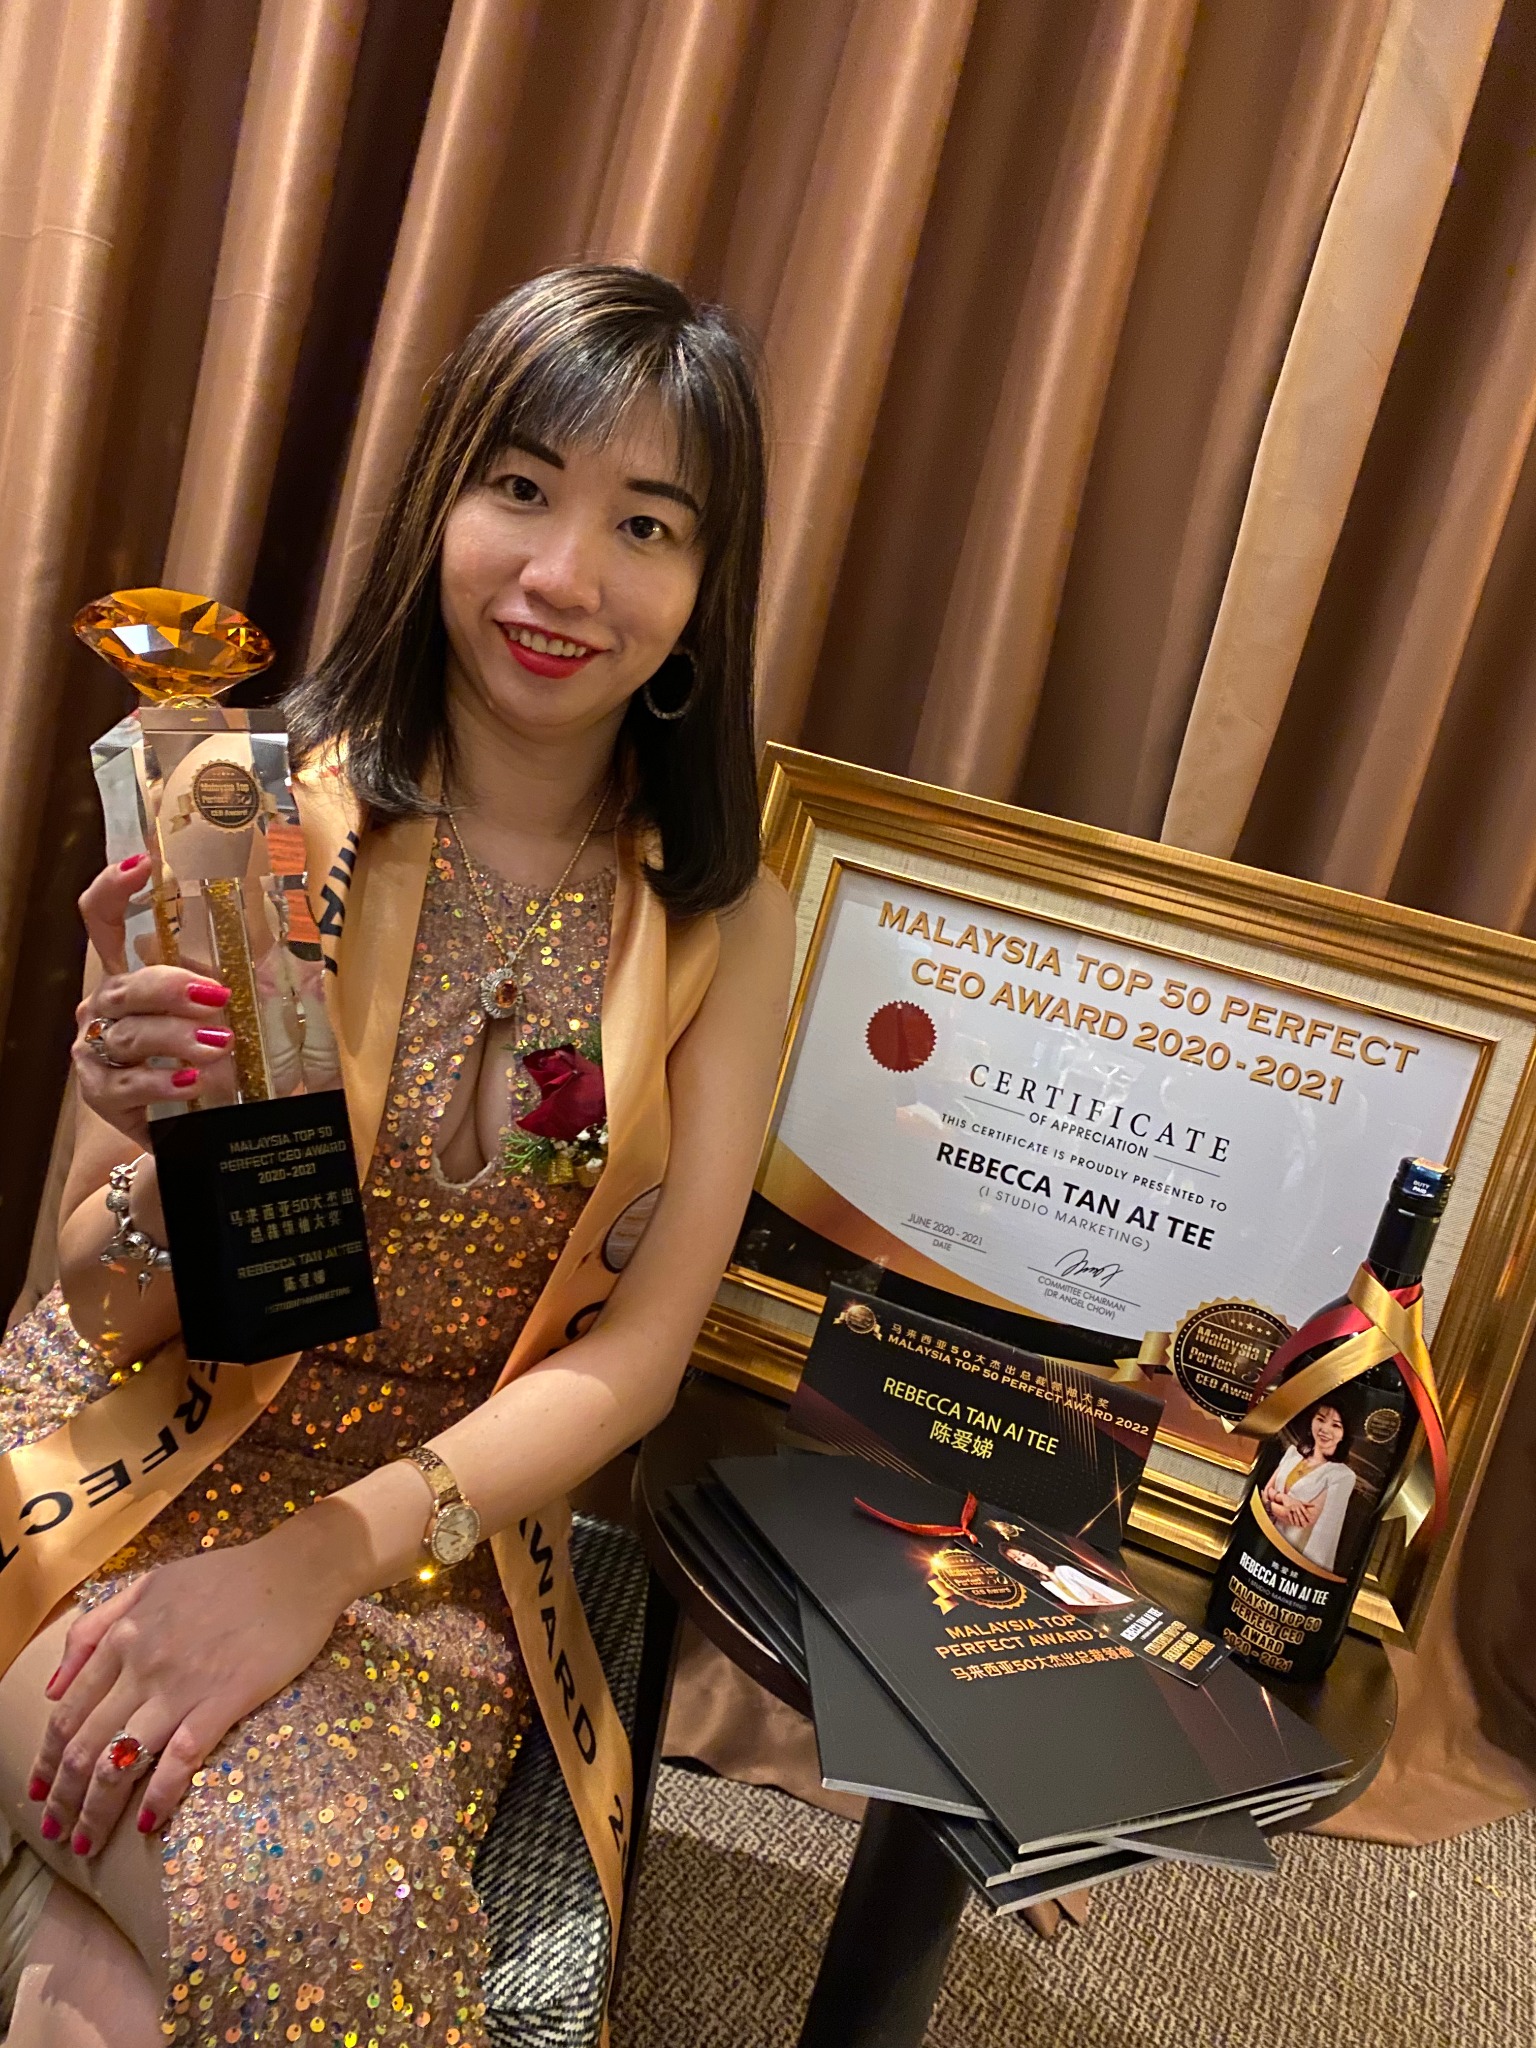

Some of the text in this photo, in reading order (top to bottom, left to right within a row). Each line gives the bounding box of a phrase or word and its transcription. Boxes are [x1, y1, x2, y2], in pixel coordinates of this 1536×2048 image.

[878, 901, 1420, 1073] MALAYSIA TOP 50 PERFECT
[911, 957, 986, 1000] CEO
[990, 981, 1128, 1041] AWARD
[1131, 1021, 1230, 1071] 2020
[1249, 1055, 1344, 1105] 2021
[969, 1063, 1231, 1163] CERTIFICATE
[1029, 1111, 1149, 1159] OF APPRECIATION
[220, 1140, 347, 1173] PERFECT CEO AWARD
[229, 1125, 333, 1153] MALAYSIA TOP 50
[941, 1112, 1227, 1212] THIS CERTIFICATE IS PROUDLY PRESENTED TO
[936, 1141, 1216, 1251] REBECCA TAN AI TEE
[907, 1212, 932, 1229] JUNE
[932, 1221, 955, 1238] 2020
[962, 1231, 983, 1247] 2021
[995, 1190, 1049, 1216] STUDIO
[1055, 1210, 1150, 1252] MARKETING)
[932, 1238, 952, 1252] DATE
[1037, 1275, 1126, 1313] COMMITTEE CHAIRMAN
[1044, 1287, 1116, 1320] (DR ANGEL CHOW)
[1188, 1346, 1238, 1375] Perfect
[1195, 1325, 1260, 1361] Malaysia
[888, 1334, 1150, 1436] MALAYSIA TOP 50 PERFECT AWARD 2022
[1195, 1373, 1265, 1404] CEO Awa
[882, 1376, 1060, 1456] REBECCA TAN AI TEE
[1239, 1551, 1329, 1606] REBECCA TAN AI TEE
[945, 1613, 1077, 1640] MALAYSIA TOP
[1229, 1575, 1322, 1632] MALAYSIA TOP 50
[1231, 1598, 1305, 1645] PERFECT CEO
[519, 1517, 598, 1765] WARD
[934, 1635, 1025, 1660] PERFECT
[1030, 1628, 1094, 1649] AWARD
[1240, 1624, 1284, 1655] AWARD
